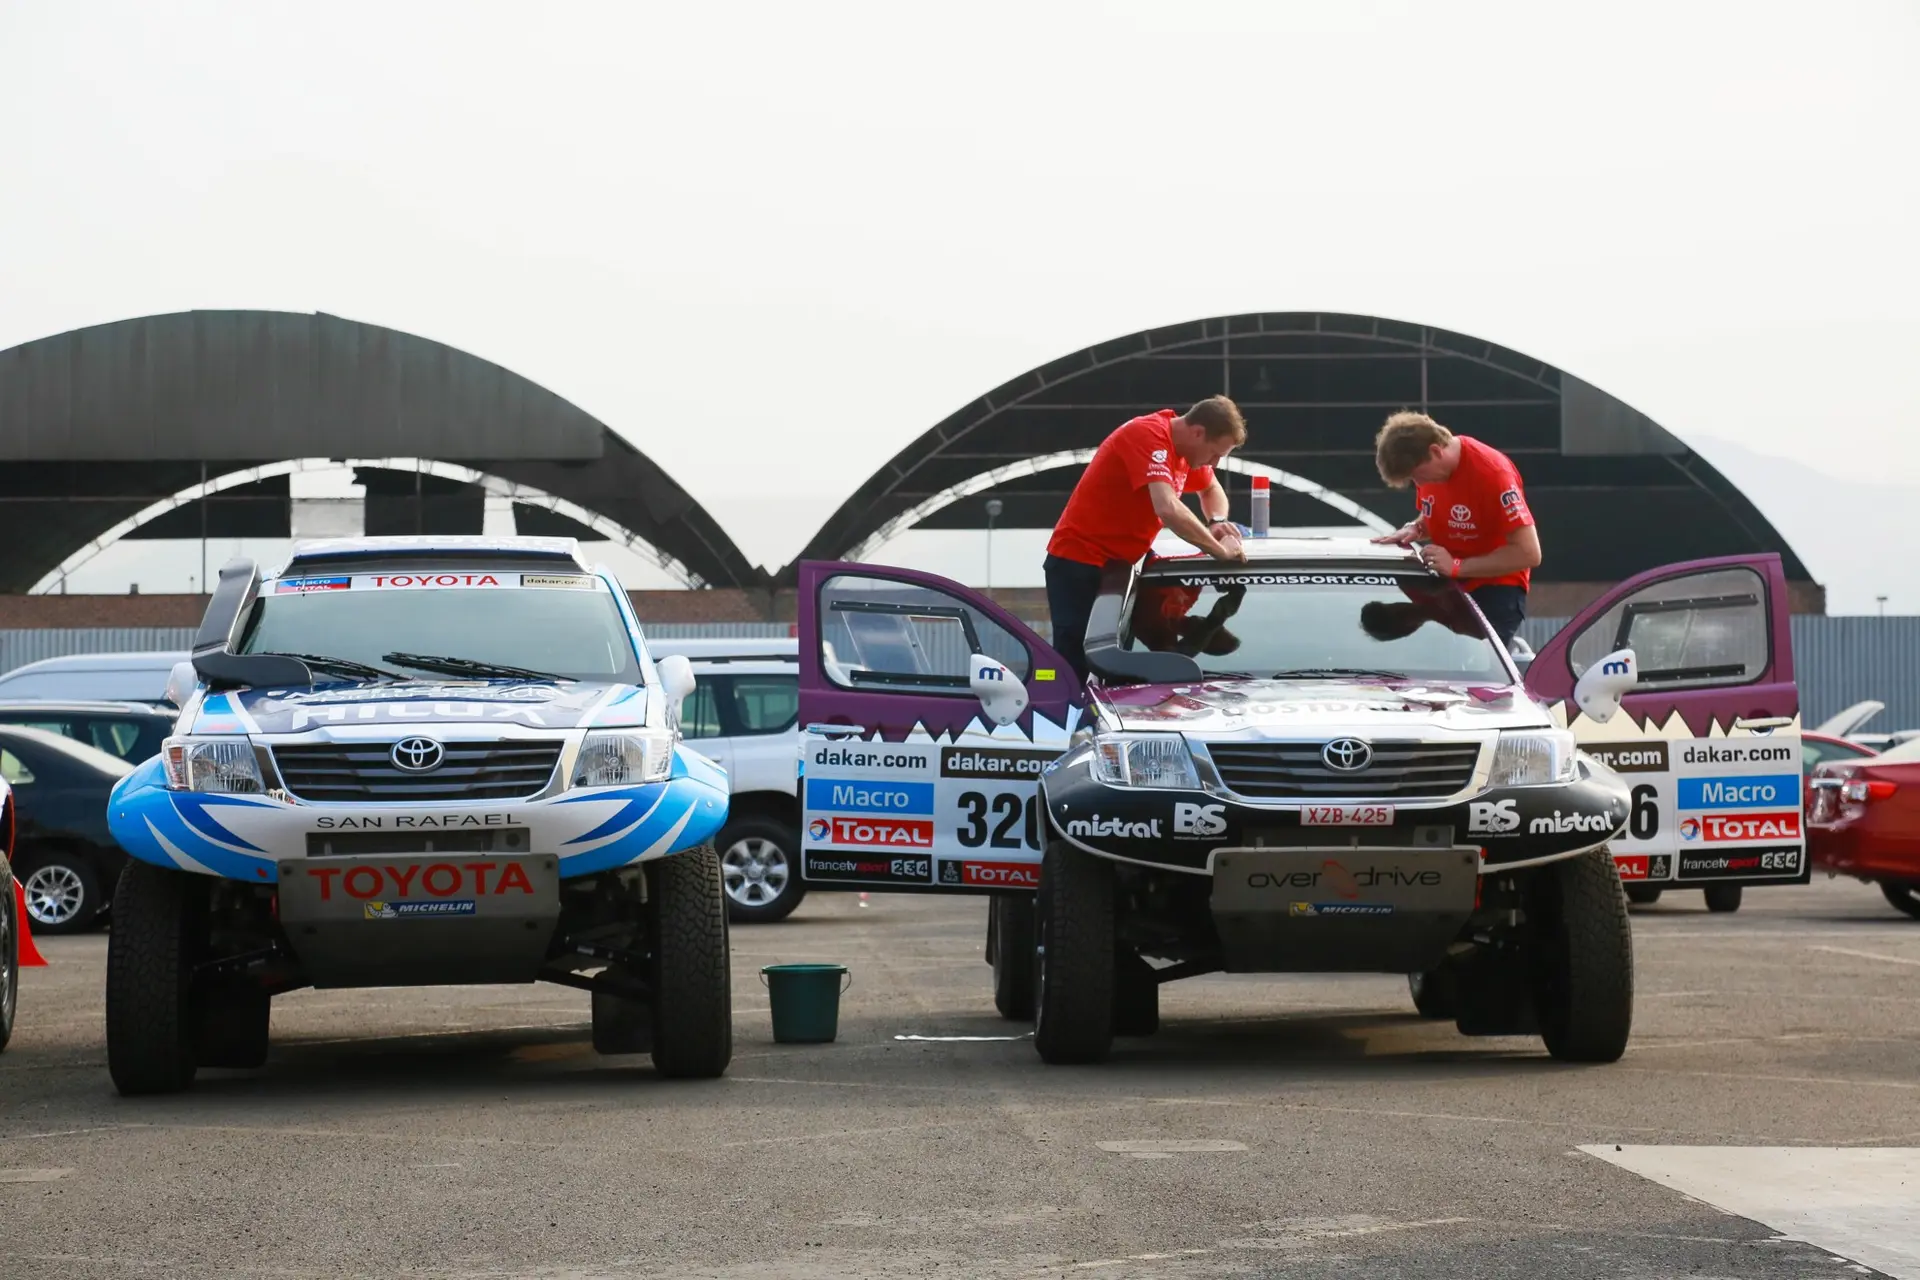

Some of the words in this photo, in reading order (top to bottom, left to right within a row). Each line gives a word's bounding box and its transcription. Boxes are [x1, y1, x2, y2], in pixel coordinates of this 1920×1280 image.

[371, 575, 500, 588] TOYOTA
[1180, 575, 1398, 586] VM-MOTORSPORT.COM
[815, 748, 927, 769] dakar.com
[1683, 746, 1791, 764] dakar.com
[832, 785, 909, 808] Macro
[1702, 782, 1776, 803] Macro
[317, 817, 381, 829] SAN
[396, 814, 522, 827] RAFAEL
[1174, 802, 1227, 836] B&S
[1308, 807, 1387, 823] XZB-425
[1469, 799, 1521, 833] B&S
[1529, 810, 1613, 834] mistral
[836, 820, 929, 844] TOTAL
[1067, 814, 1162, 838] mistral
[1706, 817, 1797, 839] TOTAL
[307, 863, 535, 902] TOYOTA
[965, 864, 1038, 882] TOTAL
[1248, 872, 1322, 888] over
[1353, 866, 1441, 886] drive
[399, 902, 474, 913] MICHELIN
[1321, 906, 1393, 914] MICHELIN
